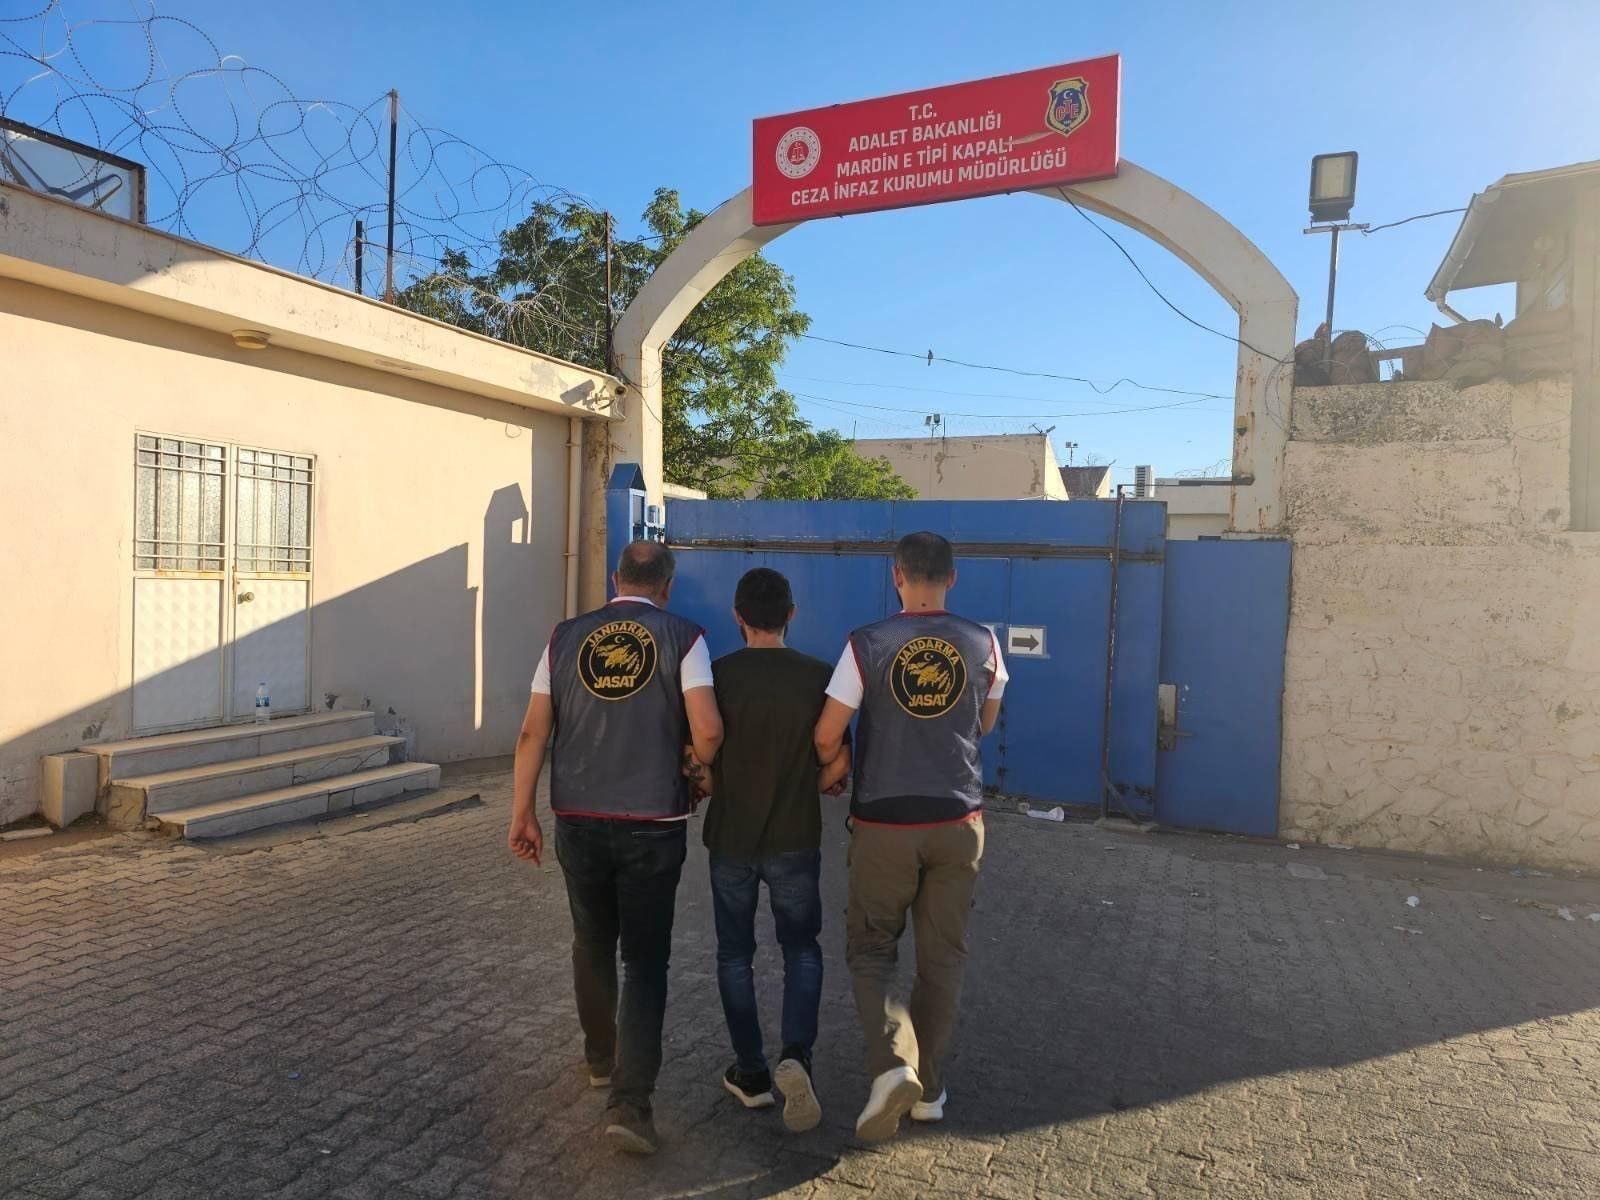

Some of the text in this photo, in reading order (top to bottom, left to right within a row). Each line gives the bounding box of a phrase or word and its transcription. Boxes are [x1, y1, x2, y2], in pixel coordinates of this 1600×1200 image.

[909, 103, 937, 120] T.C.
[848, 112, 1001, 152] ADALET BAKANLIĞI
[837, 136, 1013, 178] MARDİN E TİPİ KAPALI
[791, 147, 1067, 206] CEZA İNFAZ KURUMU MÜDÜRLÜĞÜ
[588, 622, 651, 648] JANDARMA
[899, 639, 960, 666] JANDARMA
[594, 676, 636, 688] JASAT
[908, 694, 948, 707] JASAT
